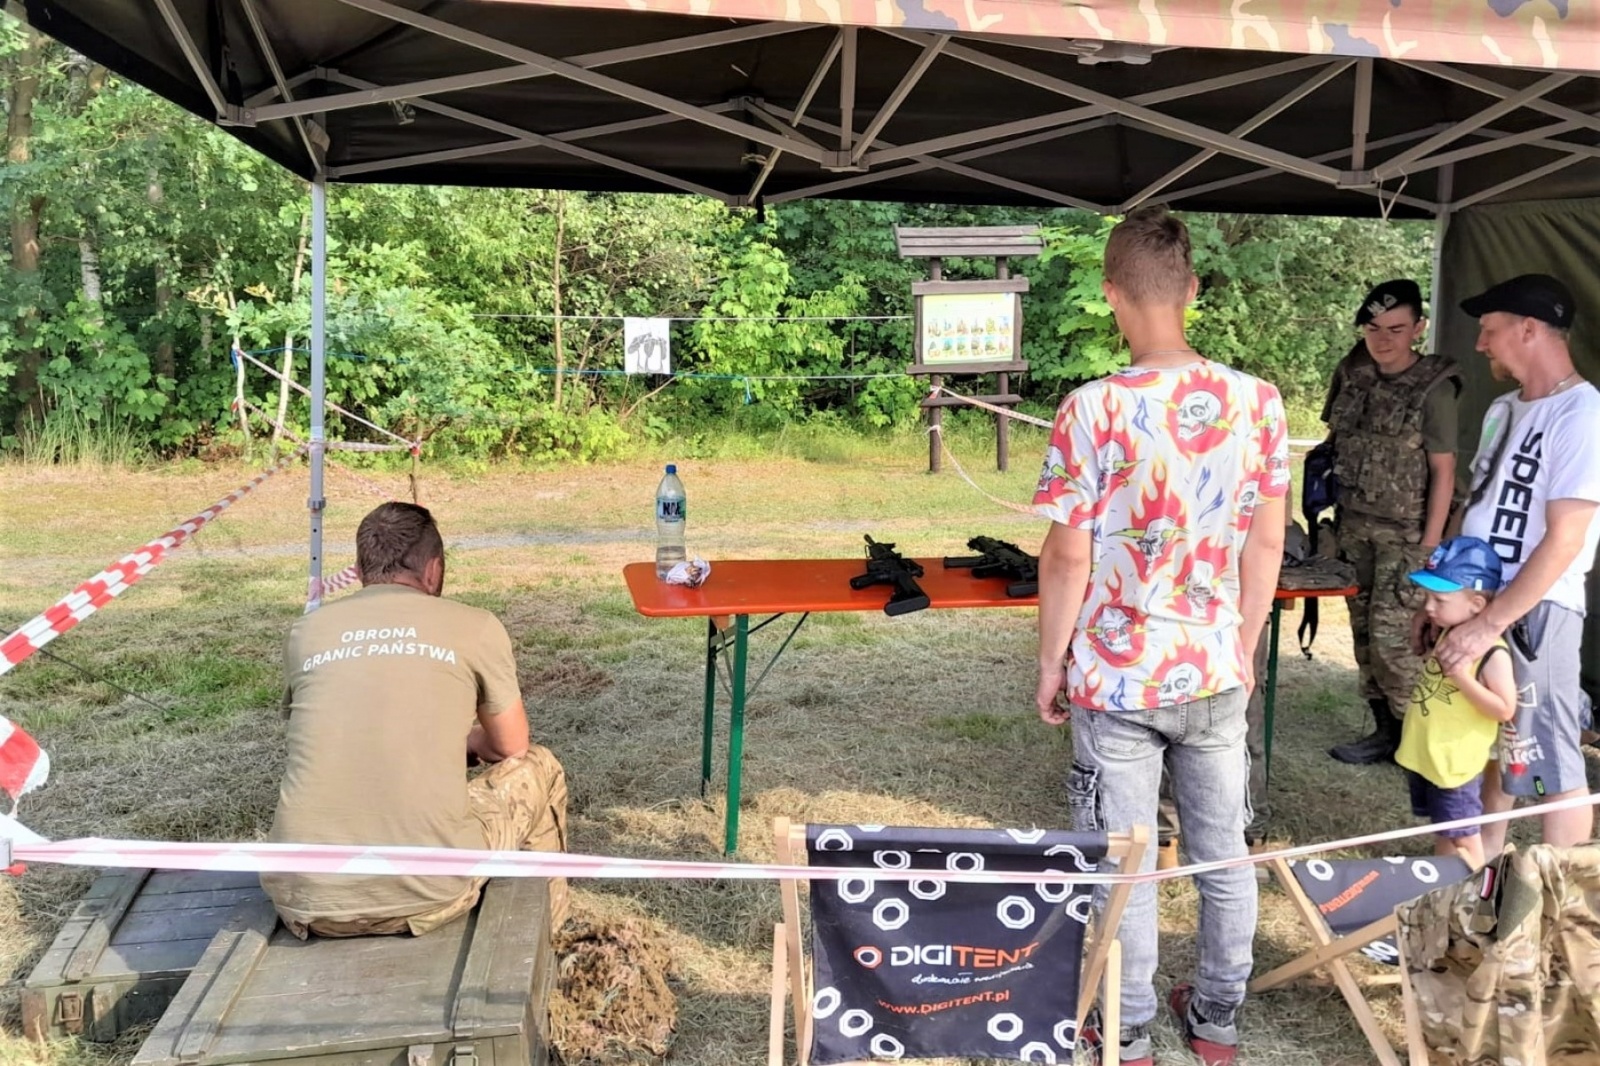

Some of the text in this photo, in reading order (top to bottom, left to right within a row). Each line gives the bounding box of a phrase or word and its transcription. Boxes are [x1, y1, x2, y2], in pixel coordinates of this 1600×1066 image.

[1488, 427, 1543, 563] SPEED
[341, 627, 417, 643] OBRONA
[302, 640, 457, 672] GRANIC PAŃSTWA
[890, 941, 1040, 968] DIGITENT
[876, 989, 1010, 1014] www.DIGITENT.pl
